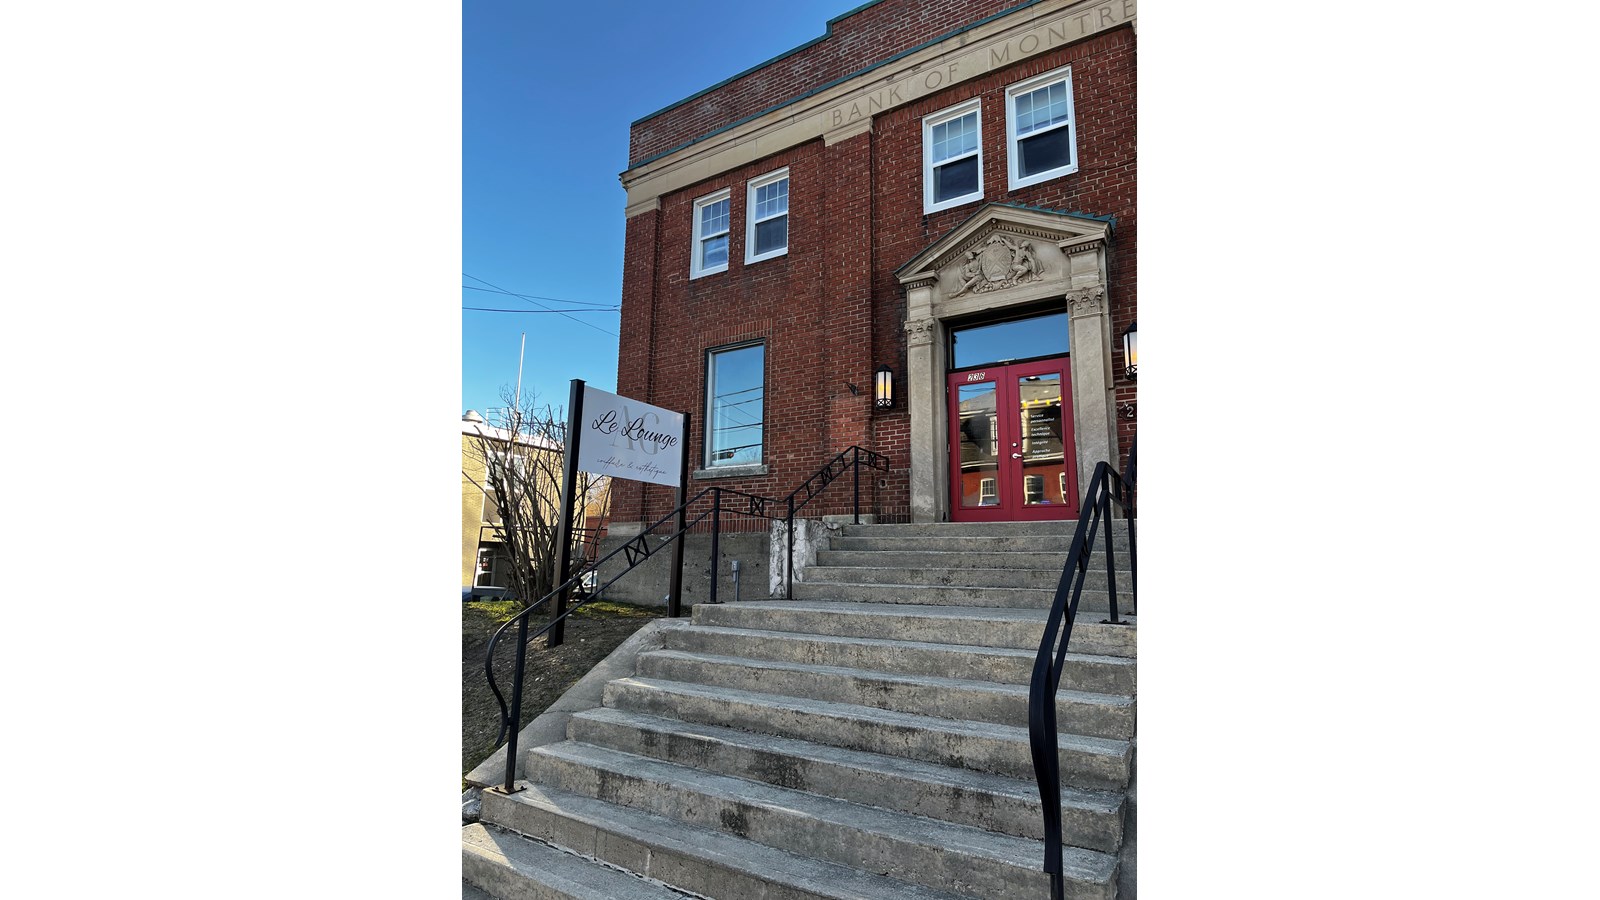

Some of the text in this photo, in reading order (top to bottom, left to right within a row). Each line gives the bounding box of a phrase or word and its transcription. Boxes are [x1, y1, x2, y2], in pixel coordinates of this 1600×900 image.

[832, 0, 1136, 127] BANK OF MONTRE
[591, 409, 679, 451] Le Lounge
